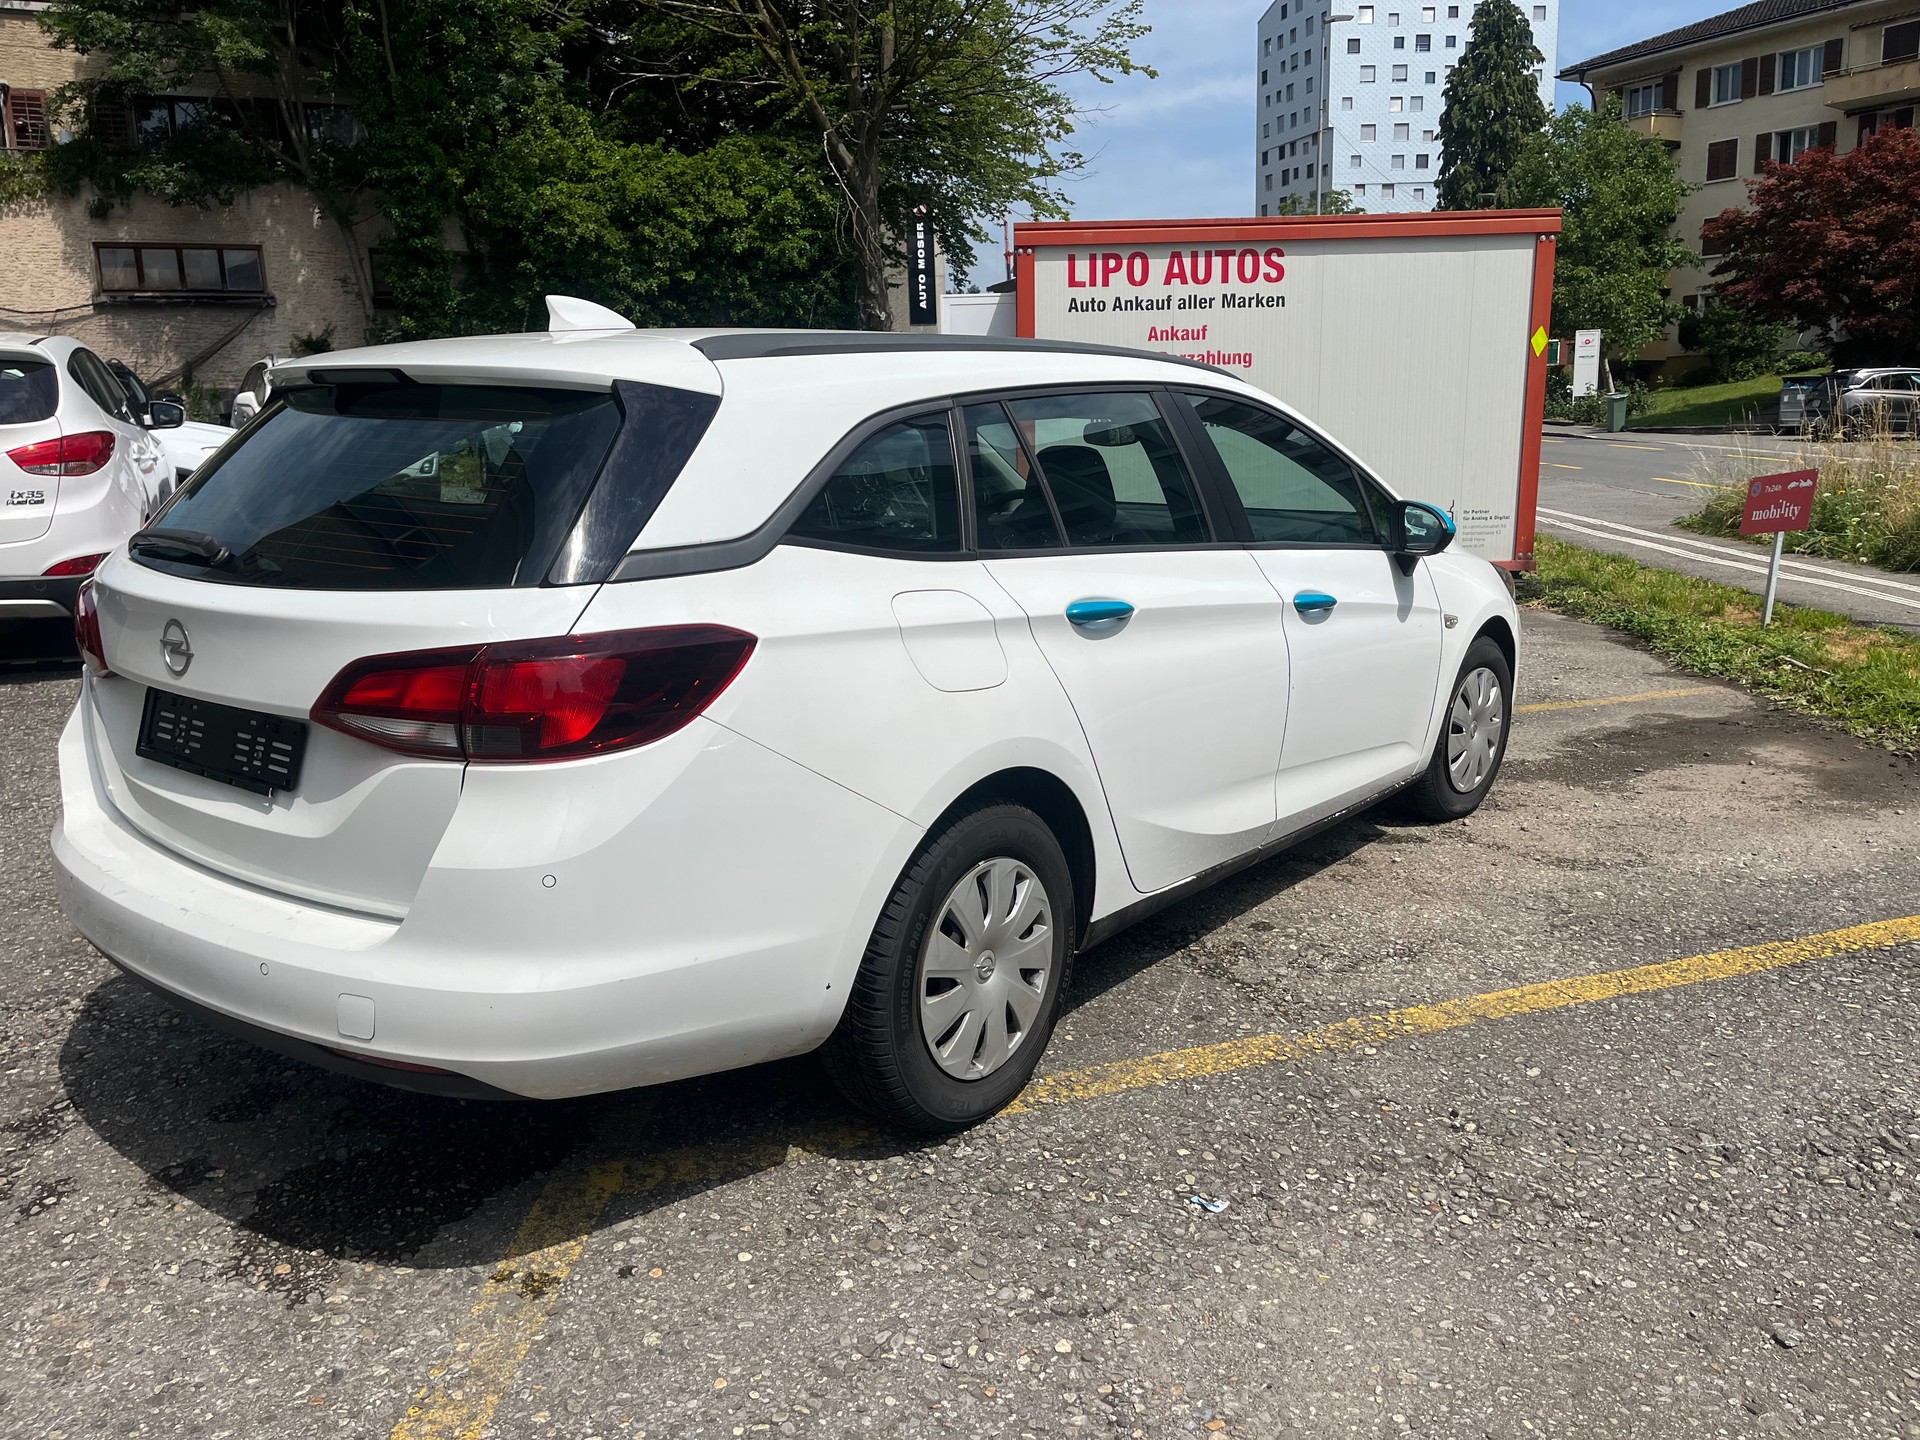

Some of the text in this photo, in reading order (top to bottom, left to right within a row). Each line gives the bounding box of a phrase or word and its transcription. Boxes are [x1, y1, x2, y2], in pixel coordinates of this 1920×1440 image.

[916, 222, 927, 309] AUTO MOSER
[1067, 247, 1285, 288] LIPO AUTOS
[1068, 292, 1286, 312] Auto Ankauf aller Marken
[1147, 324, 1208, 342] Ankauf
[1751, 499, 1802, 520] mobility
[900, 955, 913, 1031] SUPERGRIP
